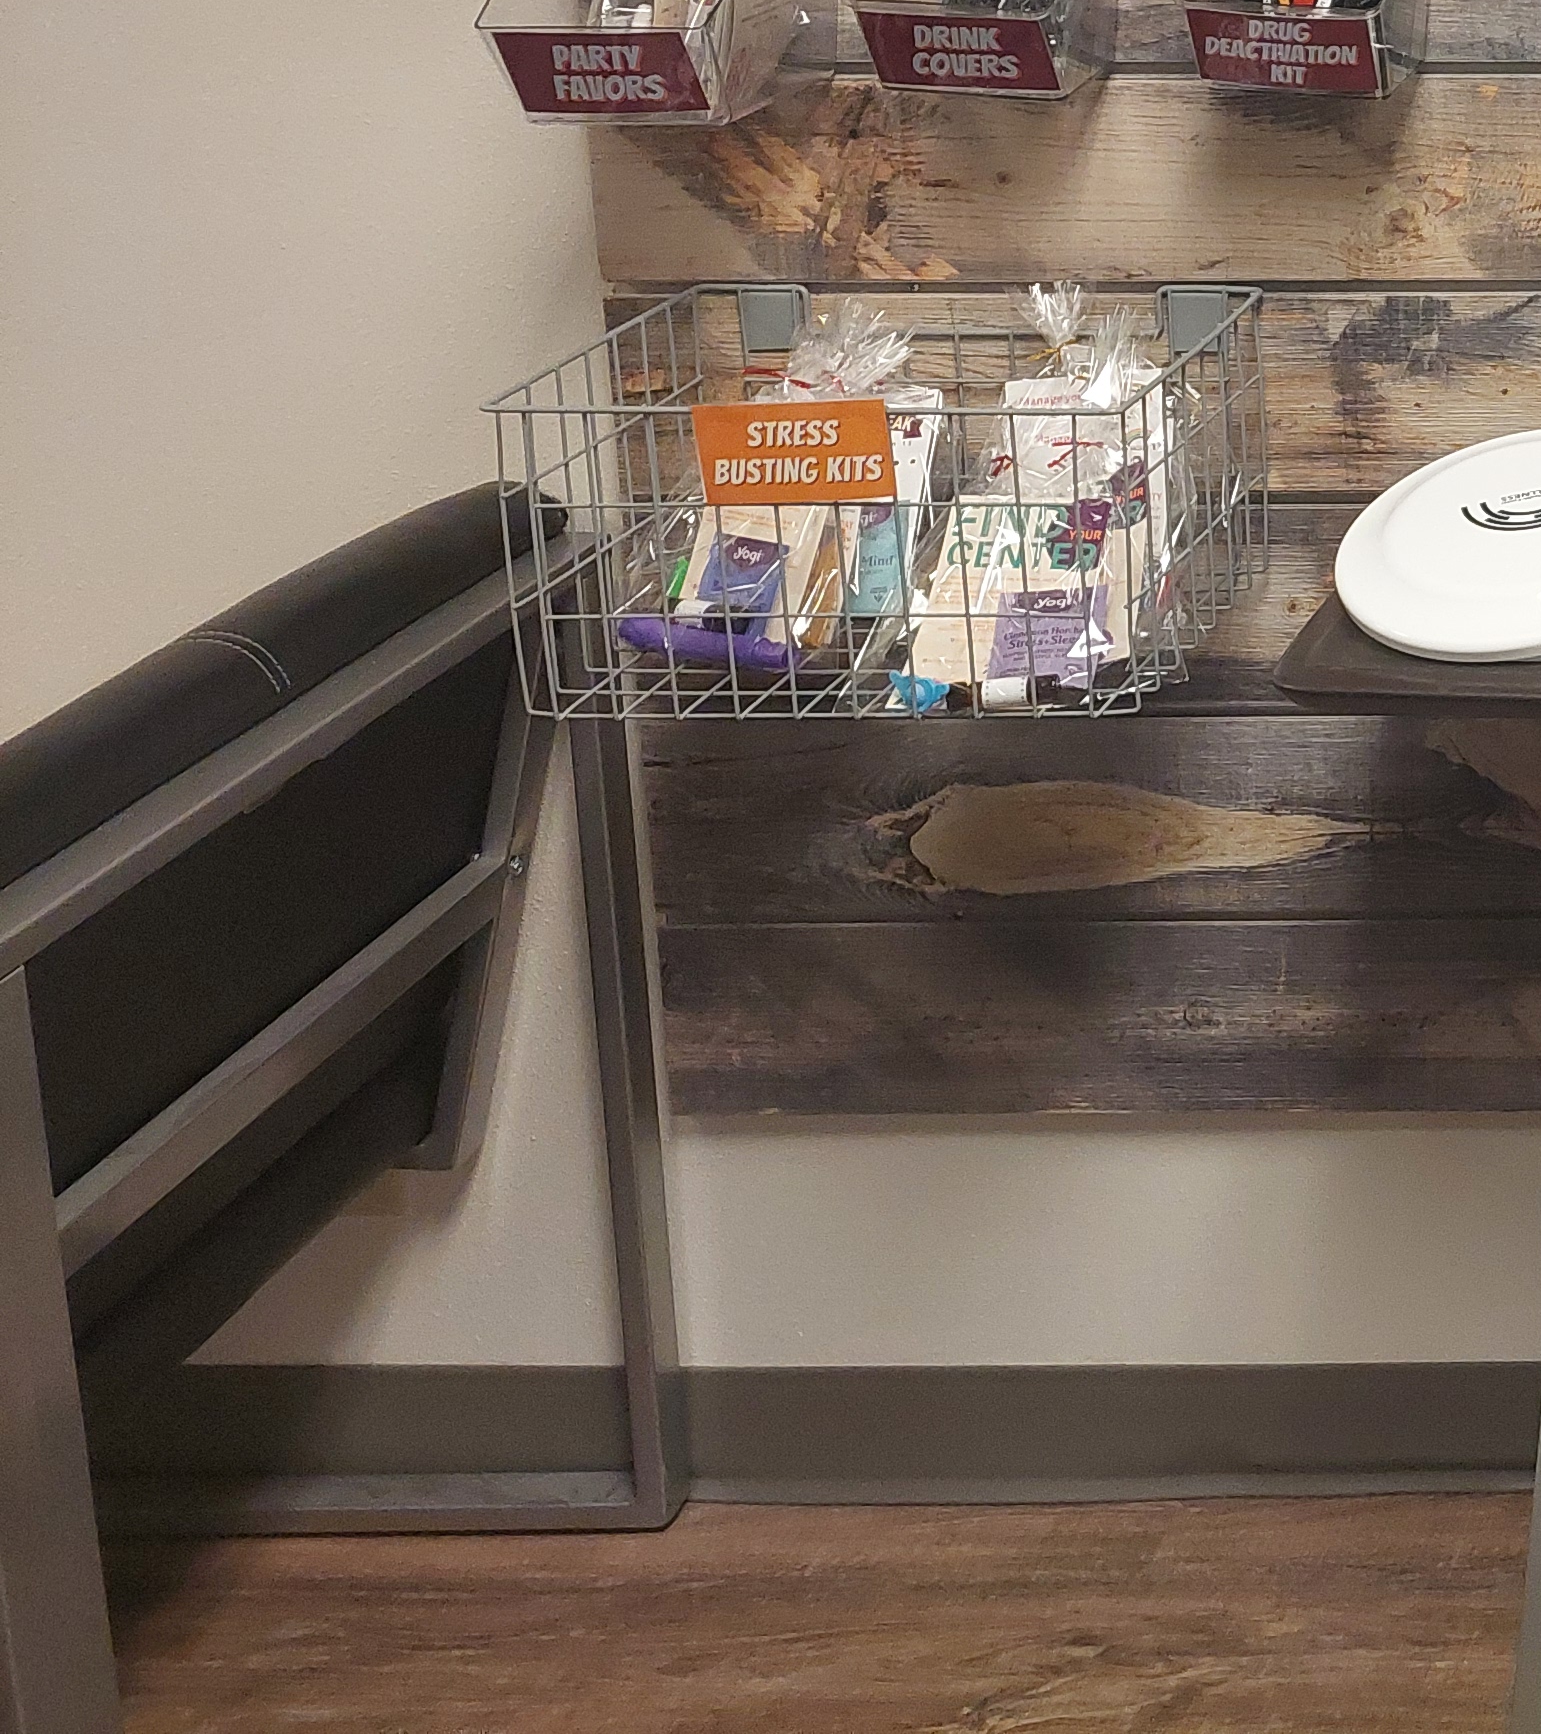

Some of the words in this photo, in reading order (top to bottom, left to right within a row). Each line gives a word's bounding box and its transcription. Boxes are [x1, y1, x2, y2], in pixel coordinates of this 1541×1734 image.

[914, 24, 1002, 51] DRINK
[1248, 19, 1312, 42] DRUG
[551, 44, 642, 72] PARTY
[912, 52, 1022, 79] COVERS
[1205, 38, 1358, 66] DEACTIVATION
[1271, 64, 1307, 85] KIT
[553, 75, 665, 102] FAVORS
[746, 419, 840, 447] STRESS
[714, 456, 818, 486] BUSTING
[825, 454, 884, 483] KITS
